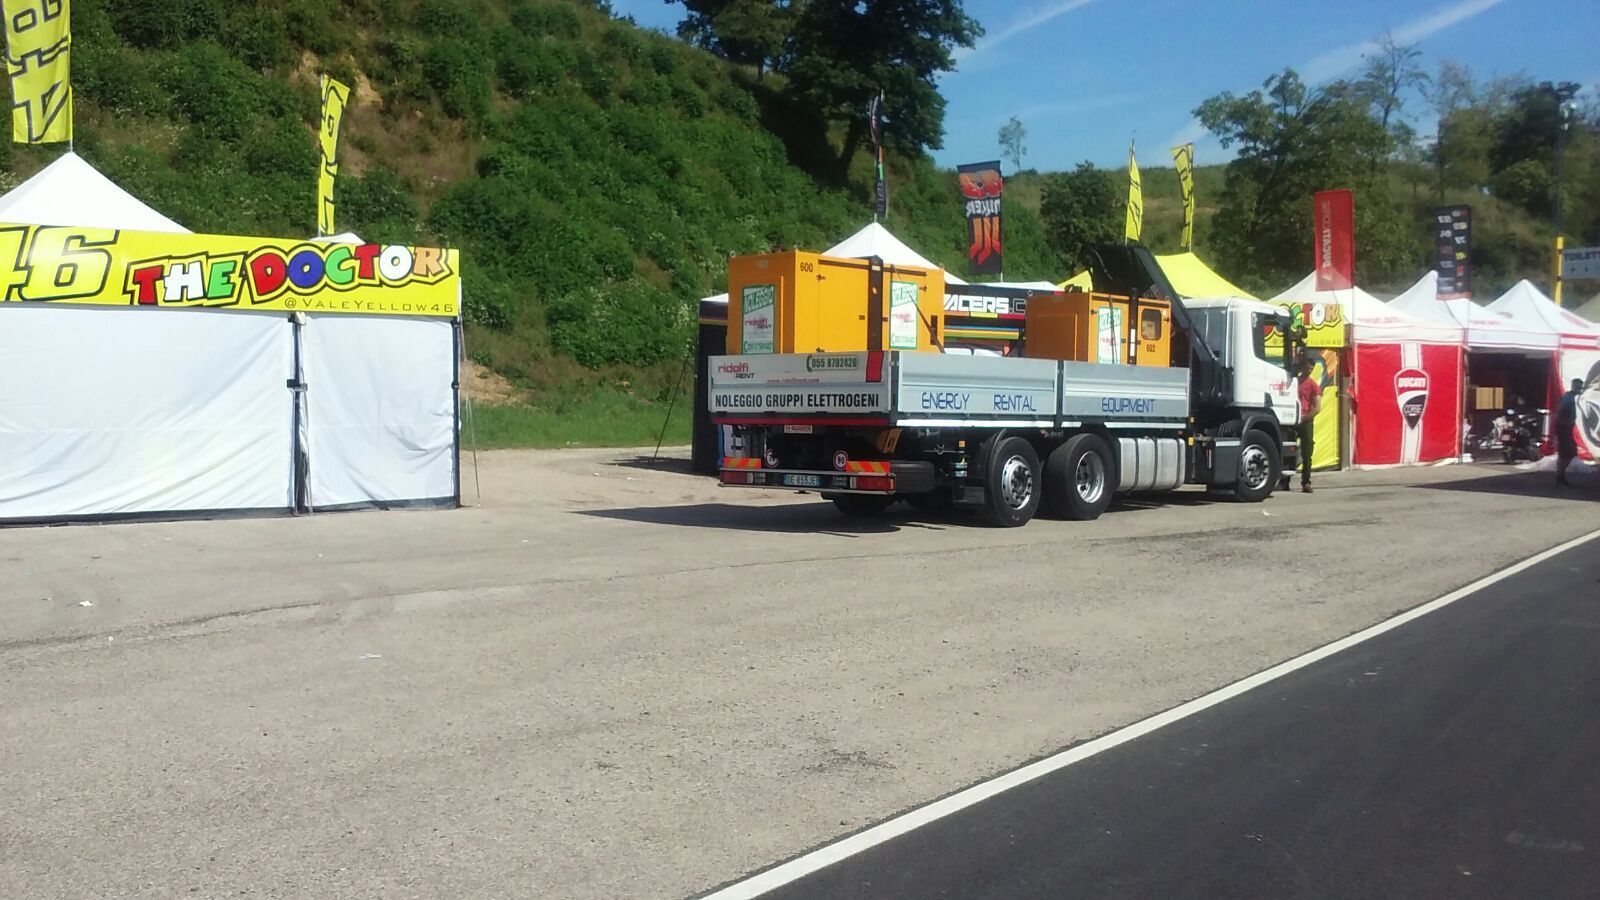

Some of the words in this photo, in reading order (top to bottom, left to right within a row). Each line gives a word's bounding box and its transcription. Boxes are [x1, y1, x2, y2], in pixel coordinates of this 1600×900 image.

[127, 254, 240, 306] THE
[250, 243, 446, 297] DOCTOR
[800, 262, 814, 273] 600
[1398, 377, 1426, 388] DUCATI
[715, 394, 763, 408] NOLEGGIO
[765, 393, 804, 407] GRUPPI
[807, 393, 879, 407] ELETTROGENI
[921, 392, 970, 410] ENERGY
[993, 394, 1037, 412] RENTAL
[1101, 397, 1155, 413] EQUIPMENT
